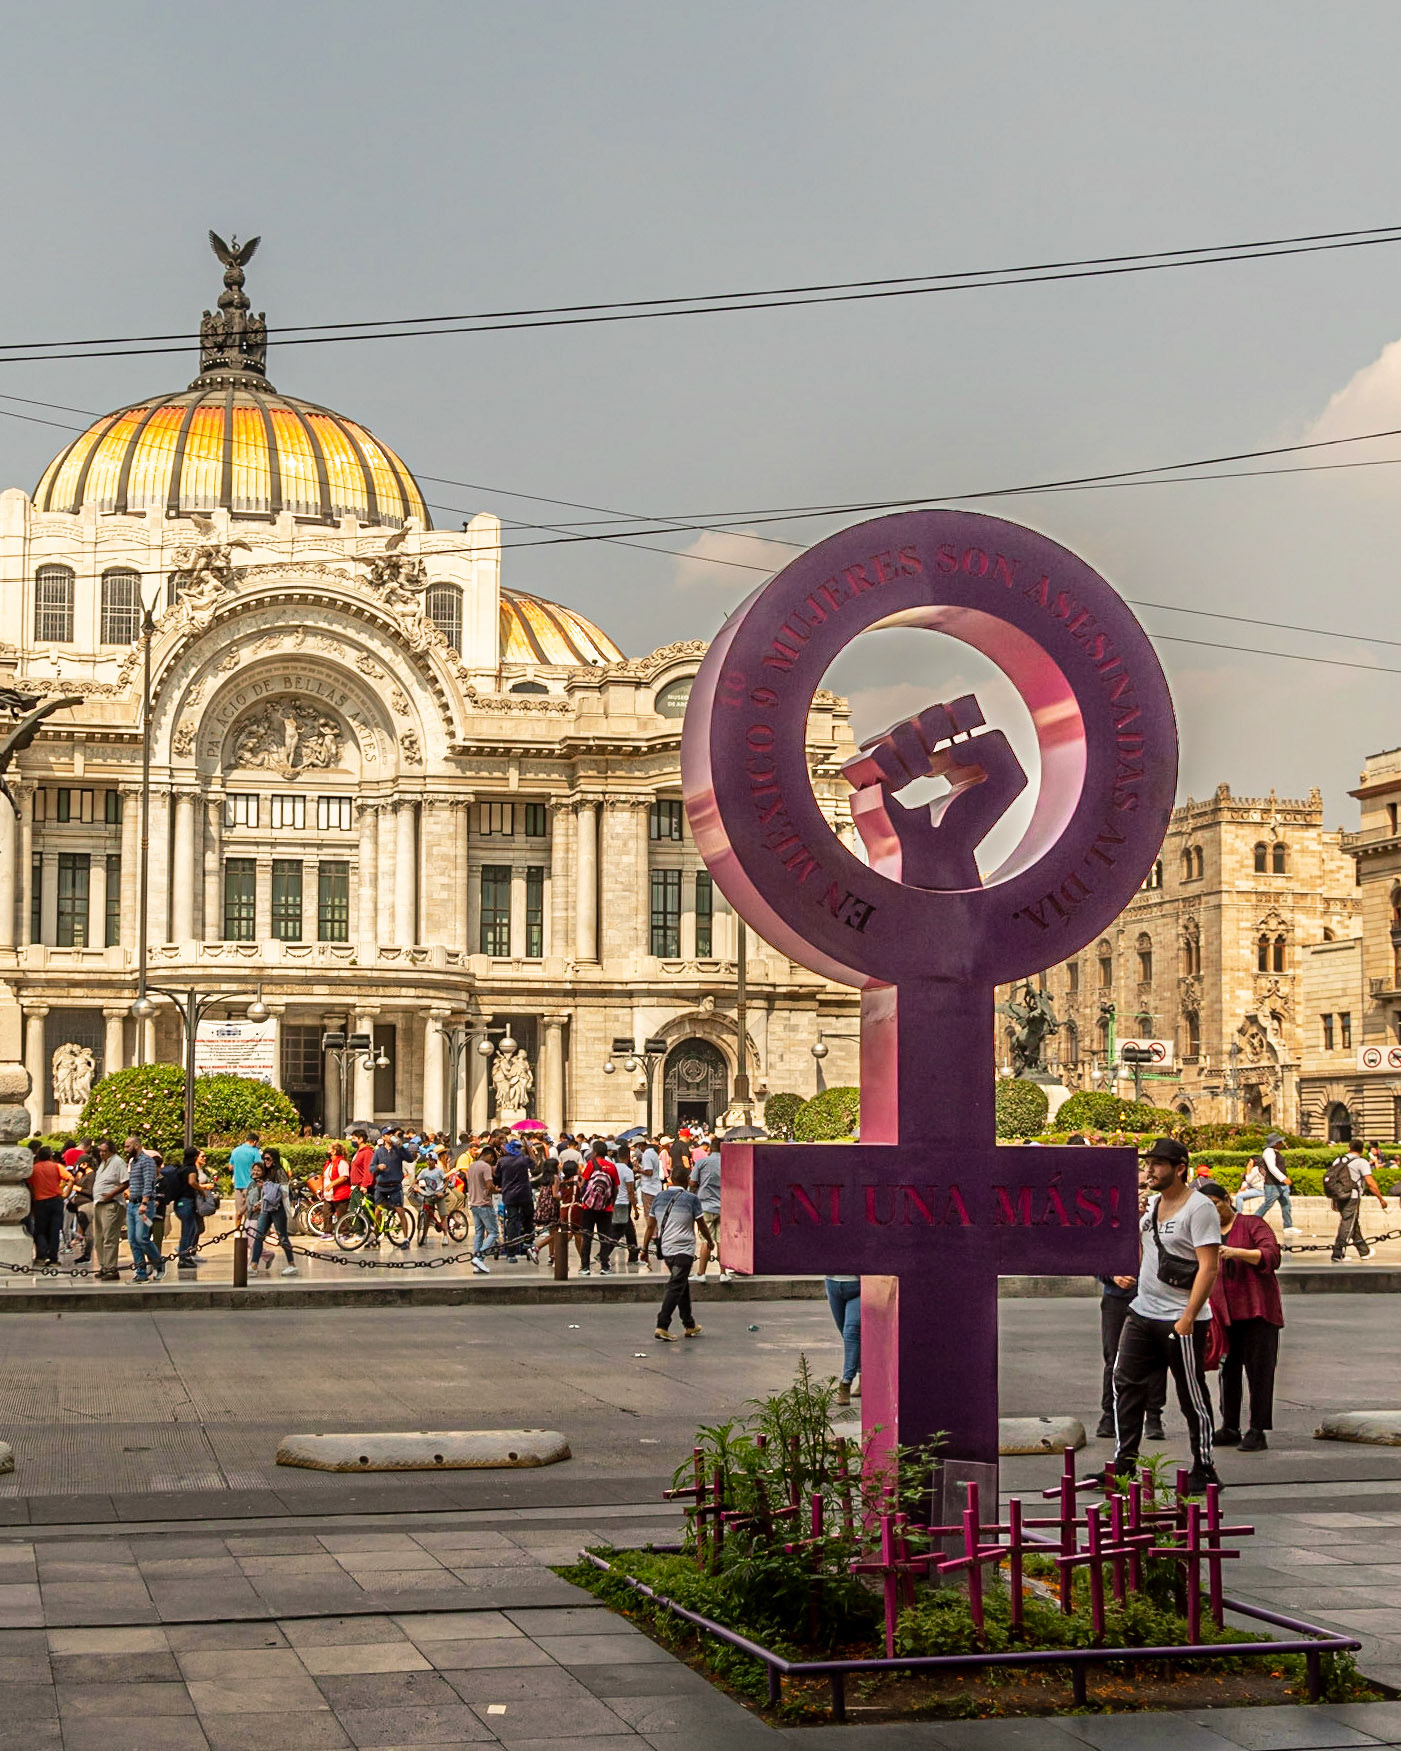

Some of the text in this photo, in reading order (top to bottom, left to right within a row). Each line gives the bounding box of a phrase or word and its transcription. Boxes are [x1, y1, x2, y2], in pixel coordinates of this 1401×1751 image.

[936, 543, 1022, 588] SON
[762, 544, 924, 674] MUJERES
[206, 676, 377, 763] PALACIO DE BELLAS ARTES
[751, 687, 778, 708] 9
[1023, 574, 1145, 812] ASESINADAS
[746, 724, 823, 883] MÉXICO
[1083, 818, 1128, 869] AL
[816, 881, 877, 934] EN
[771, 1171, 1121, 1236] ¡NI UNA MÁS!
